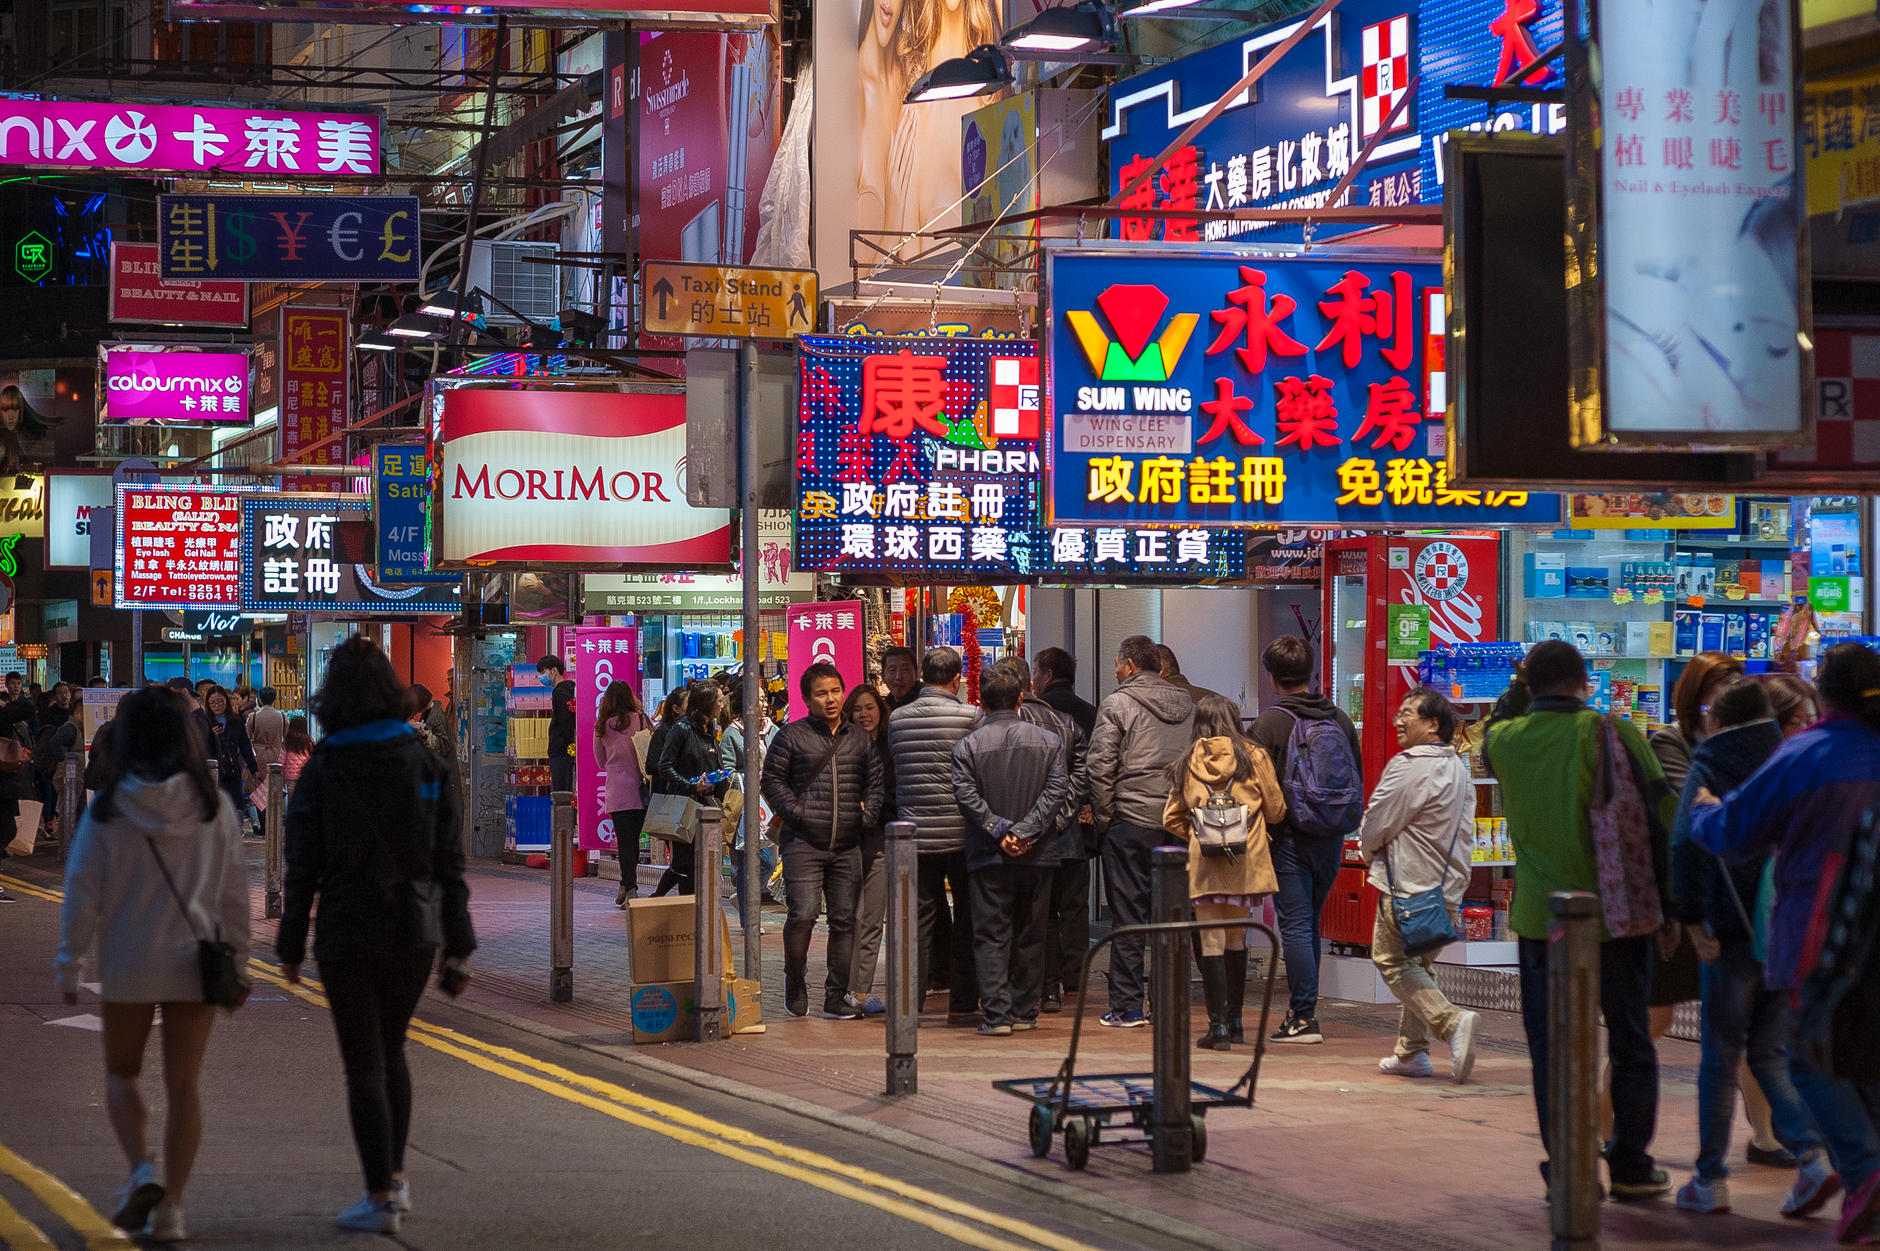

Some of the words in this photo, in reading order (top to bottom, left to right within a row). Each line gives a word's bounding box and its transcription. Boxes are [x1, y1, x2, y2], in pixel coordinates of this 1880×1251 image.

[1615, 86, 1786, 126] 專業美甲
[172, 113, 374, 174] 卡萊美
[1614, 133, 1789, 172] 植眼睫毛
[1613, 179, 1649, 194] Nail
[1654, 181, 1666, 194] &
[1670, 180, 1731, 198] Eyelash
[681, 276, 719, 293] Taxi
[727, 279, 783, 297] Stand
[691, 299, 771, 328] 的士站
[1204, 265, 1414, 374] 永利
[108, 373, 223, 392] colourmix
[180, 394, 240, 412] 卡萊美
[858, 349, 949, 438] 康
[1078, 386, 1125, 411] SUM
[1133, 387, 1192, 412] WING
[1197, 374, 1423, 451] 大藥房
[1090, 418, 1133, 432] WING
[1139, 419, 1165, 432] LEE
[1080, 434, 1176, 448] DISPENSARY
[1088, 455, 1288, 504] 政府註冊
[388, 483, 423, 498] Sati
[841, 482, 1005, 518] 政府註冊
[132, 495, 192, 510] BLING
[132, 521, 200, 532] BEAUTY
[172, 511, 220, 523] (SALLY)
[758, 521, 791, 530] SHIO
[263, 513, 340, 549] 政府
[388, 526, 419, 543] 4/F
[840, 523, 1007, 561] 環球西藥
[1050, 527, 1211, 564] 優質正貨
[263, 557, 341, 594] 註冊
[134, 586, 156, 597] 2/F
[161, 586, 186, 596] Tel:
[692, 595, 743, 606] 1/f.,Lockhar
[758, 596, 773, 605] oad
[775, 596, 791, 605] 523
[793, 612, 855, 631] 卡萊美
[581, 638, 628, 654] 卡萊美
[647, 935, 673, 945] papa
